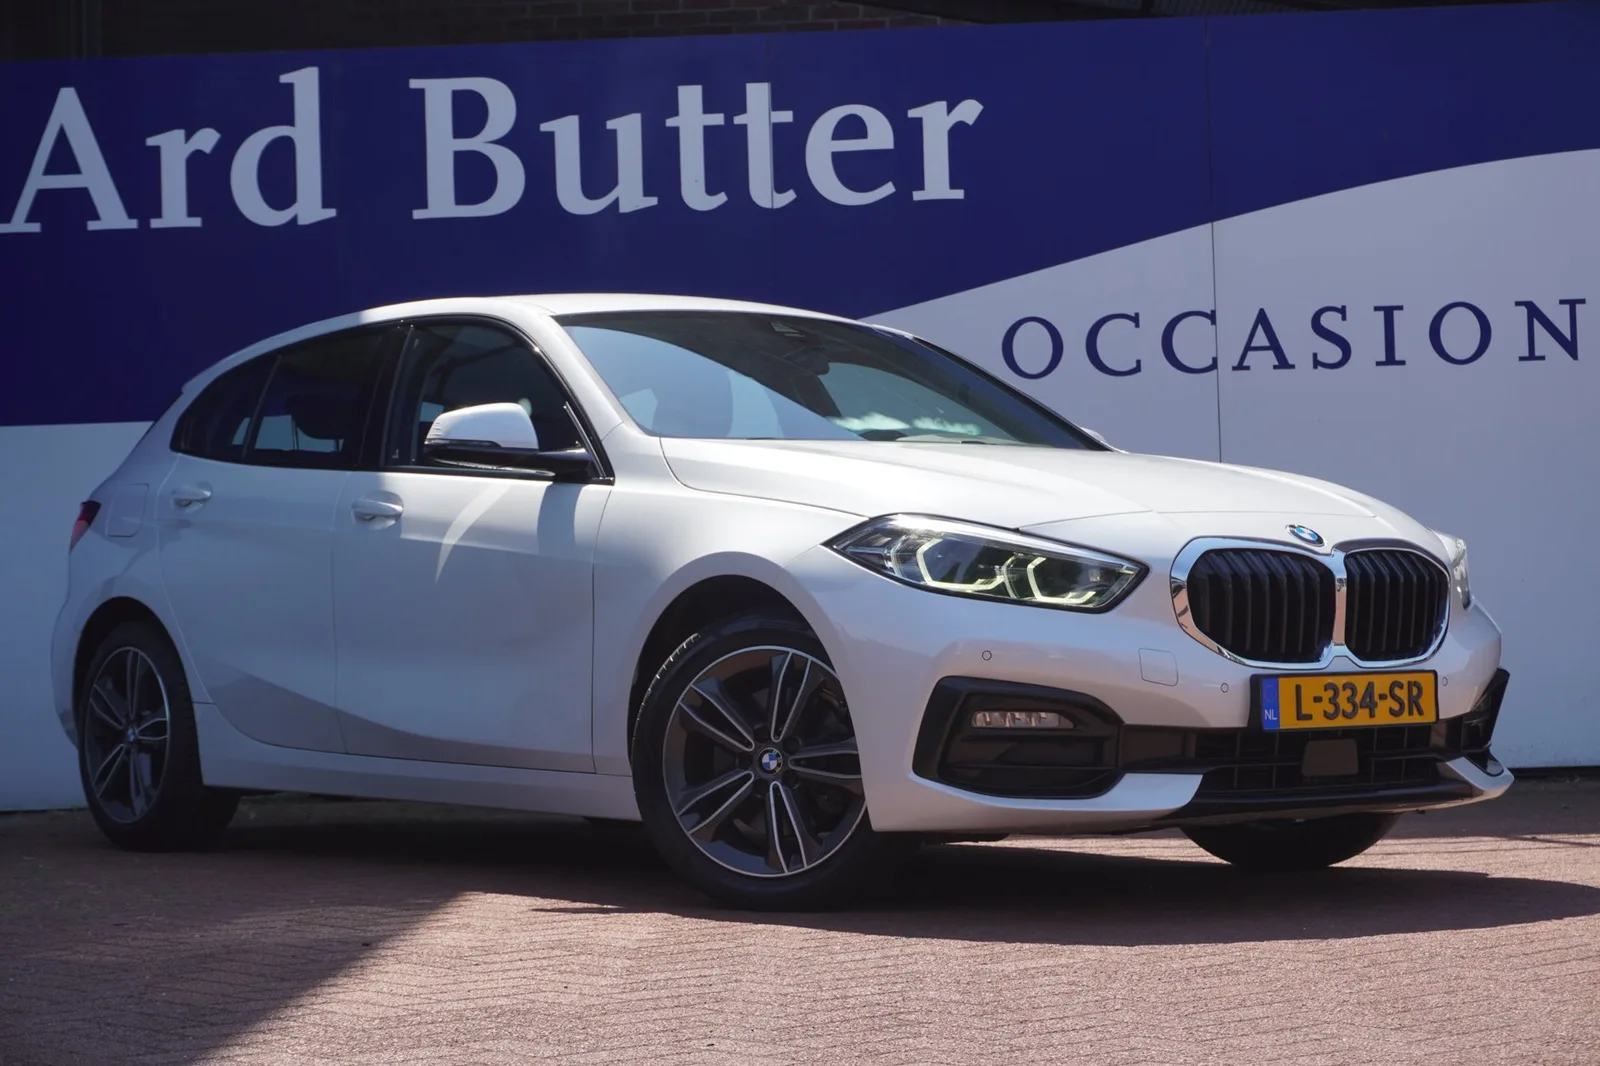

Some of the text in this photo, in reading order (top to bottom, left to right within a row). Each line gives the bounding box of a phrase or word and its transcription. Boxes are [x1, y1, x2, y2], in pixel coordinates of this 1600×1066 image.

[0, 66, 985, 234] Ard Butter
[1001, 298, 1587, 380] OCCASION
[1264, 709, 1278, 721] NL
[1295, 680, 1425, 721] L-334-SR
